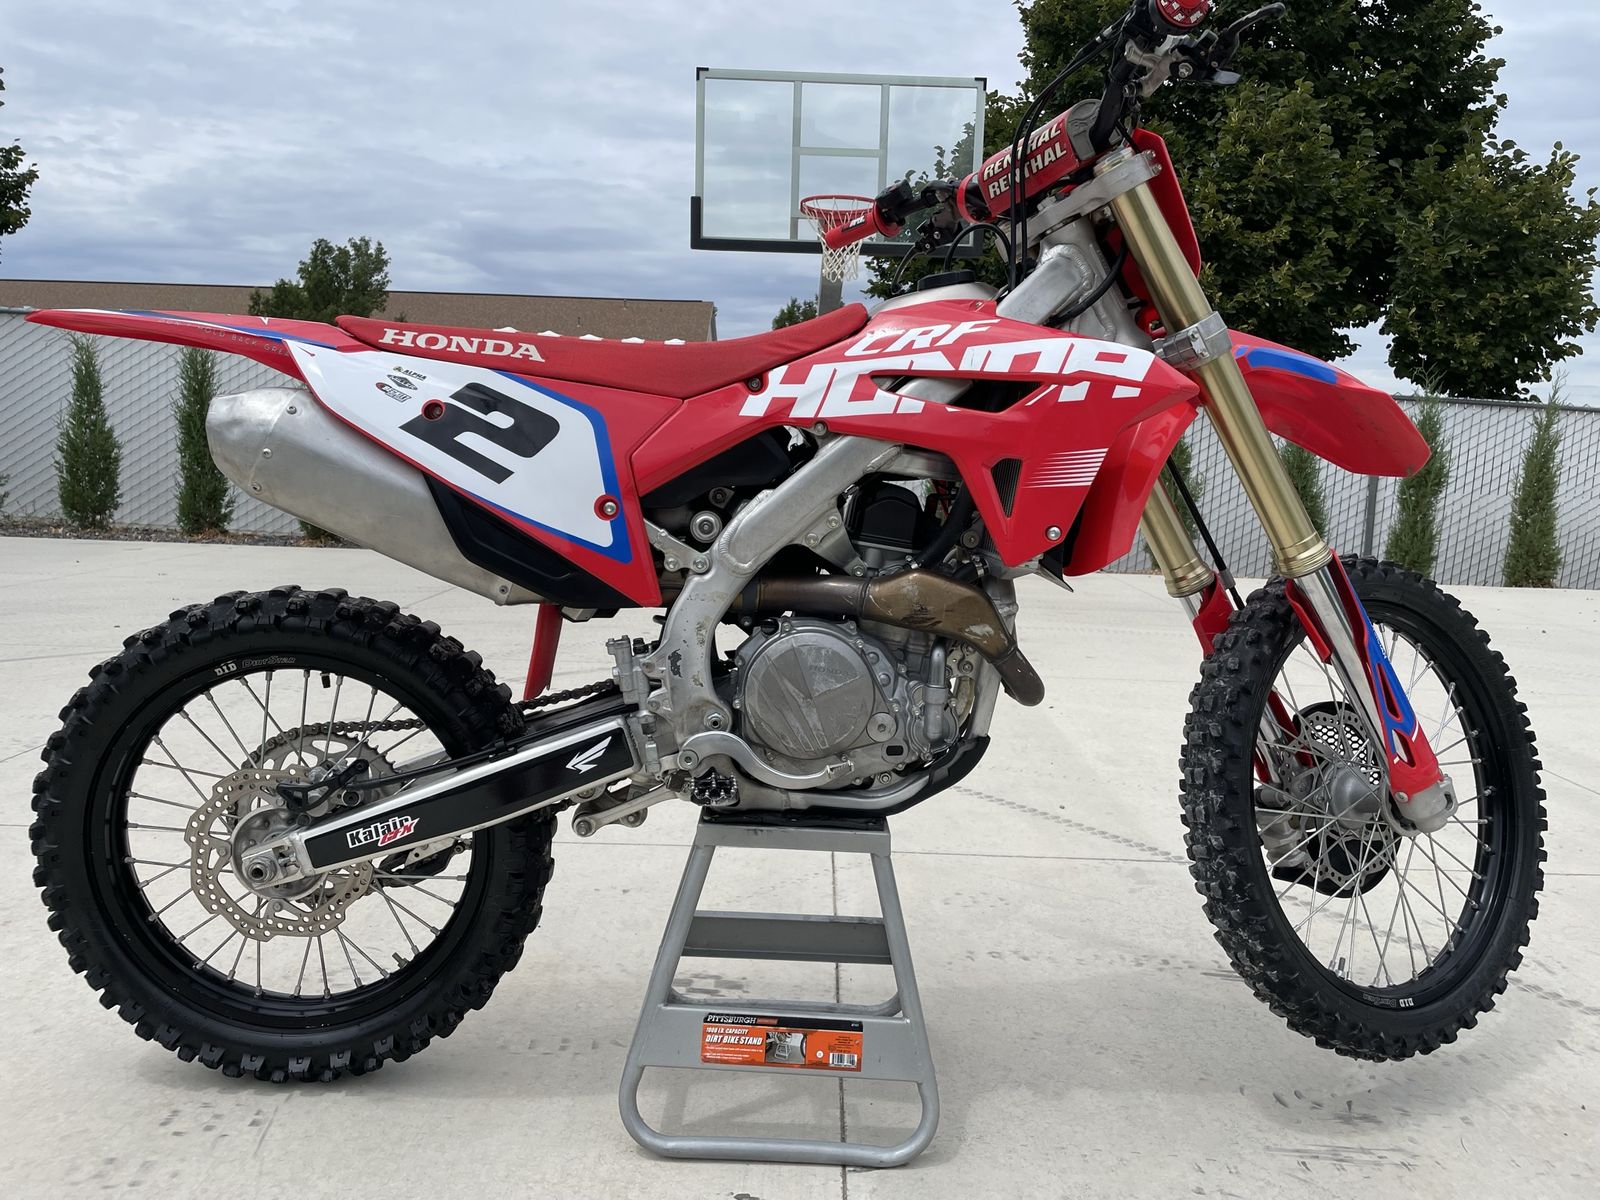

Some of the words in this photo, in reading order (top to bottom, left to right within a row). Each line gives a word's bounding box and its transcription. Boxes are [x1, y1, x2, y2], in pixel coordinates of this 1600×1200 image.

[231, 333, 257, 346] BACK
[844, 319, 1000, 356] CRF
[378, 328, 546, 363] HONDA
[403, 369, 427, 381] ALPHA
[398, 382, 561, 485] 2
[707, 1014, 757, 1024] PITTSBURGH
[705, 1034, 722, 1043] DIRT
[722, 1035, 740, 1044] BIKE
[740, 1036, 763, 1046] STAND
